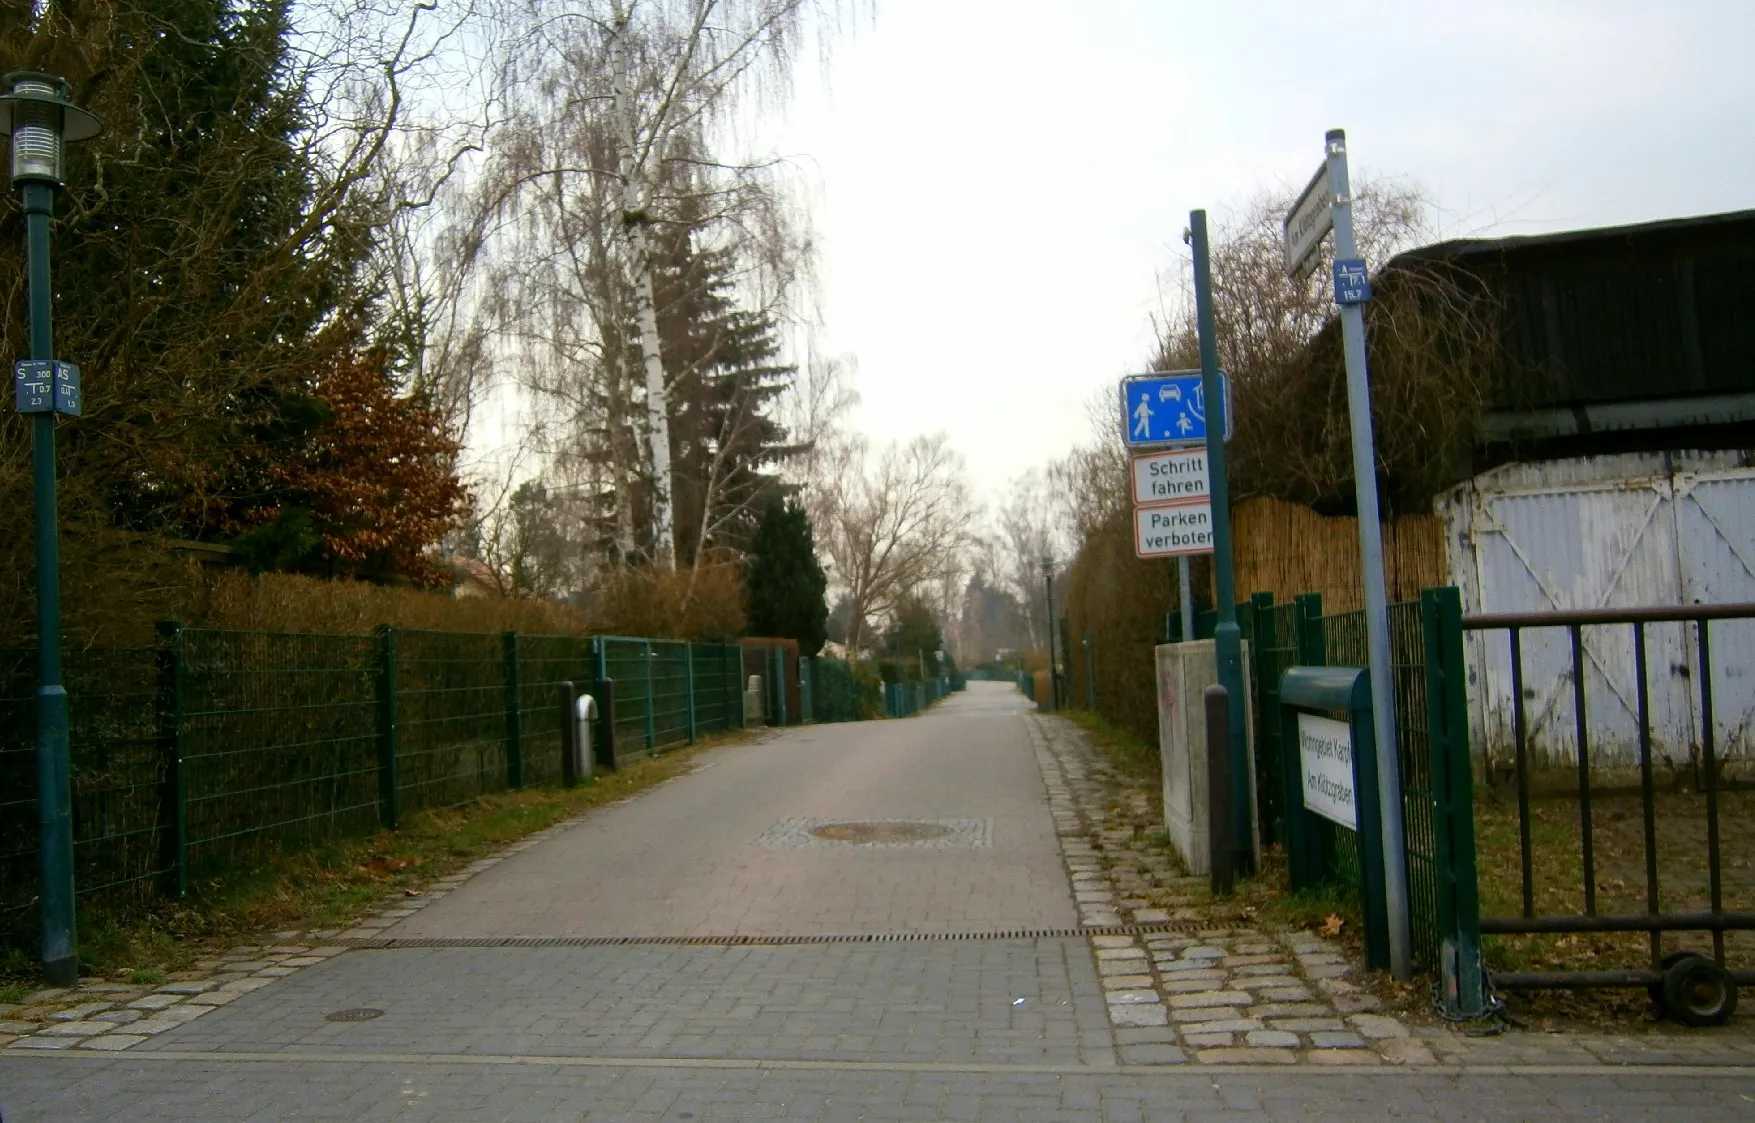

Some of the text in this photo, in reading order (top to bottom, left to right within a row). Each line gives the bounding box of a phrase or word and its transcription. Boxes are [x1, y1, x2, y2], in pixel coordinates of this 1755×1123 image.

[18, 368, 26, 379] S
[58, 368, 69, 380] AS
[1149, 457, 1203, 476] Schritt
[1151, 478, 1204, 496] fahren
[1151, 512, 1207, 529] Parken
[1307, 767, 1317, 789] Am
